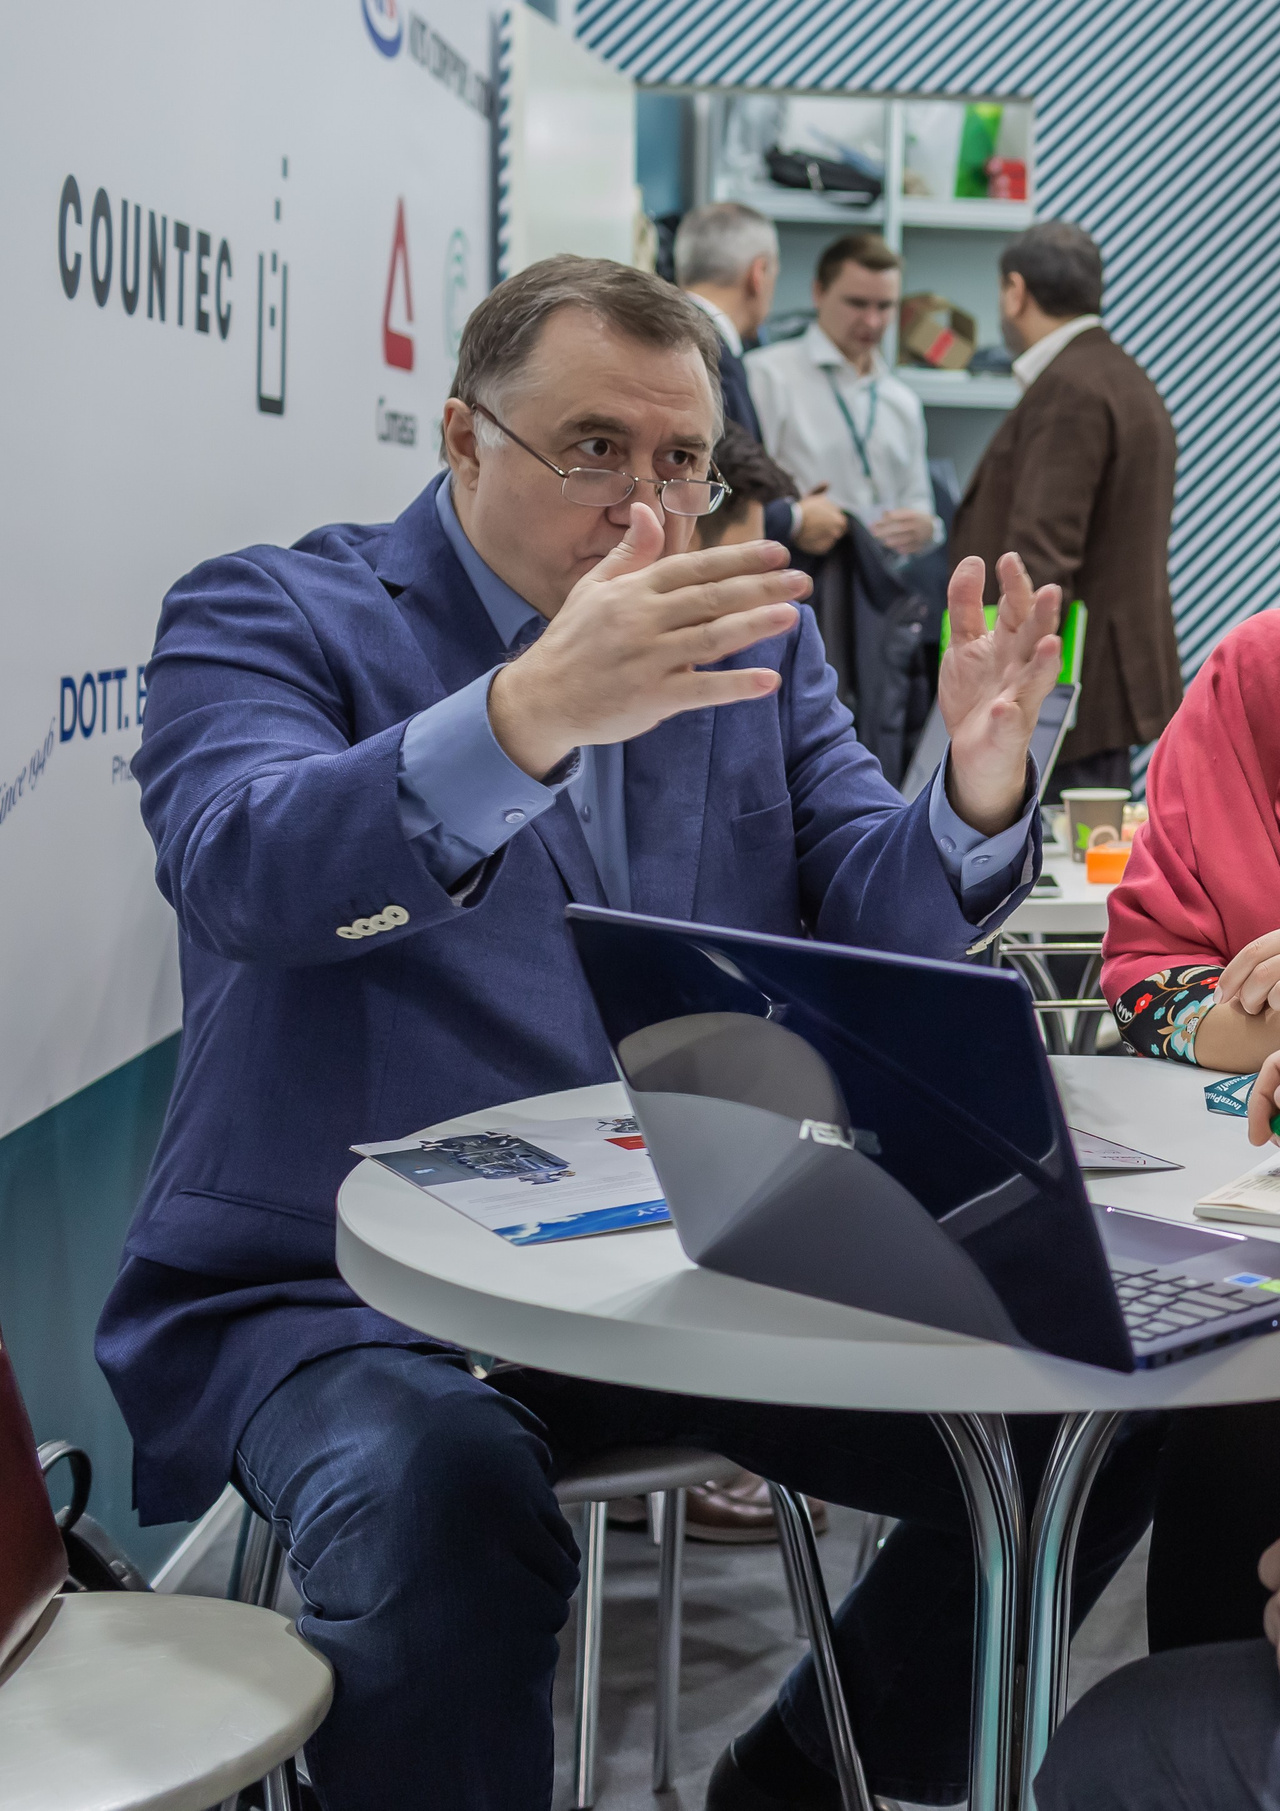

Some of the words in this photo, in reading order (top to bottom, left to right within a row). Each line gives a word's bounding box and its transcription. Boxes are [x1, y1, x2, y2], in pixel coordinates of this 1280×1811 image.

[58, 173, 233, 341] COUNTEC
[60, 667, 129, 743] DOTT.
[0, 765, 27, 826] ince
